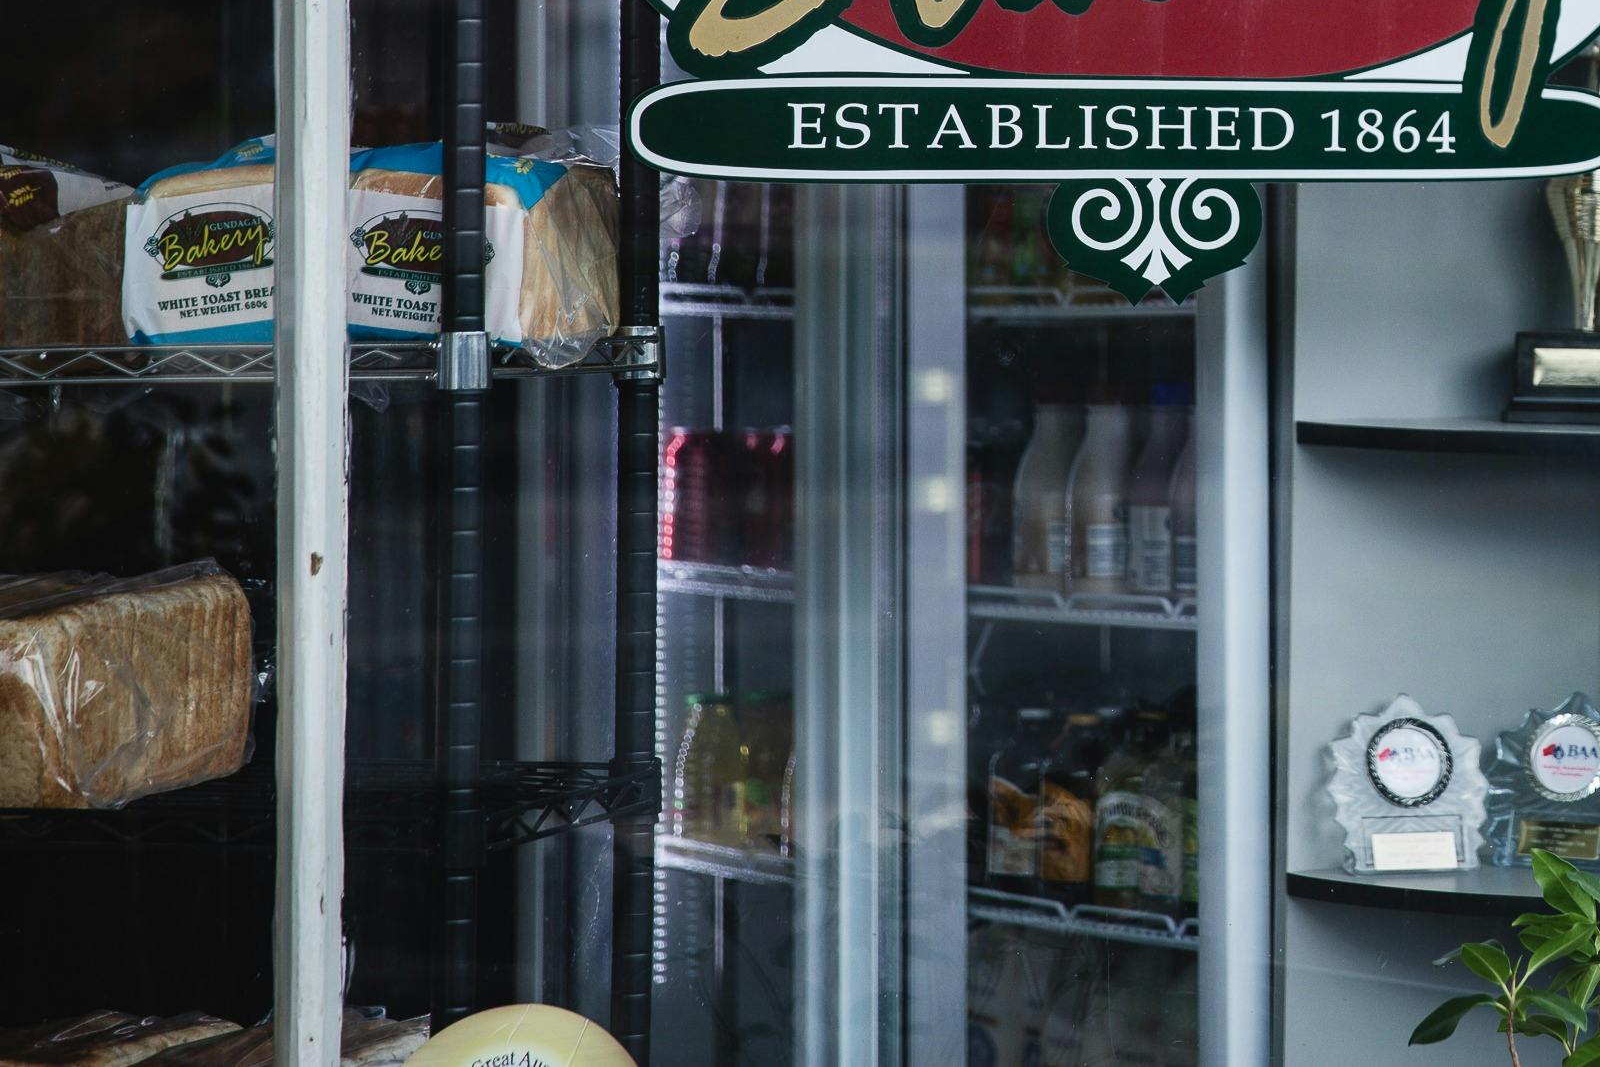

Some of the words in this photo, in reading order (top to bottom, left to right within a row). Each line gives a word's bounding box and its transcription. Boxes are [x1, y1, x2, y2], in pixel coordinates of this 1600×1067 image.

[787, 101, 1297, 154] ESTABLISHED
[1320, 109, 1457, 156] 1864
[209, 216, 262, 231] GUNDAGAI
[156, 223, 269, 270] Bakery
[364, 230, 443, 266] Bake
[158, 298, 198, 311] WHITE
[201, 291, 240, 305] TOAST
[244, 286, 274, 300] BREA
[352, 292, 392, 307] WHITE
[396, 298, 437, 313] TOAST
